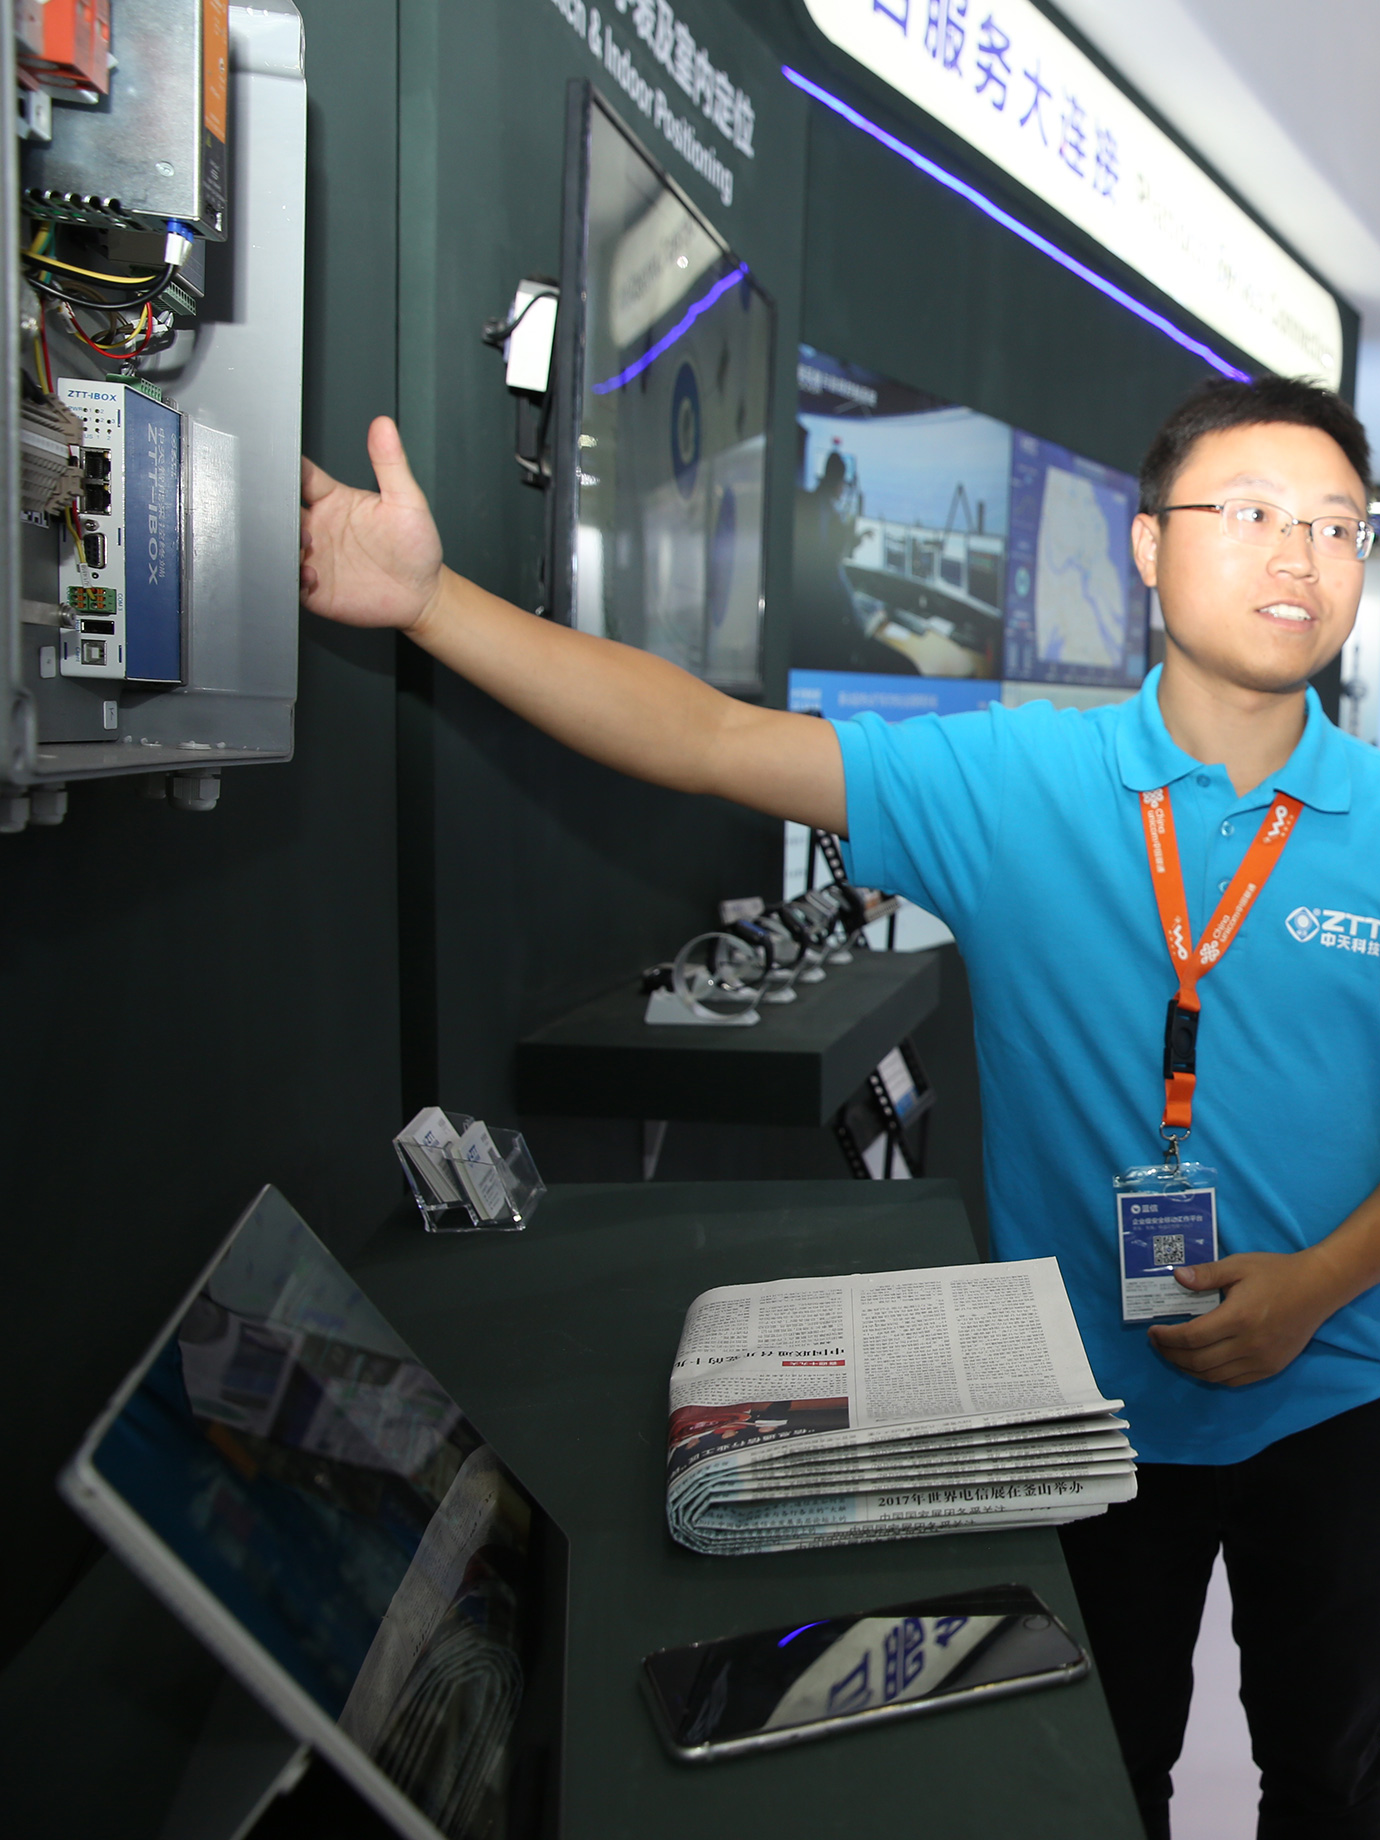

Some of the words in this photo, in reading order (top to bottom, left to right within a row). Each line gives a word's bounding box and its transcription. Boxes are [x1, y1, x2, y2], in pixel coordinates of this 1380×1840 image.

[604, 24, 654, 118] Indoor
[654, 87, 734, 207] Positioning
[67, 390, 117, 402] ZTT-IBOX
[148, 423, 158, 585] ZTT-IBOX
[878, 1480, 1084, 1507] 2017年世界电信展在釜山举办
